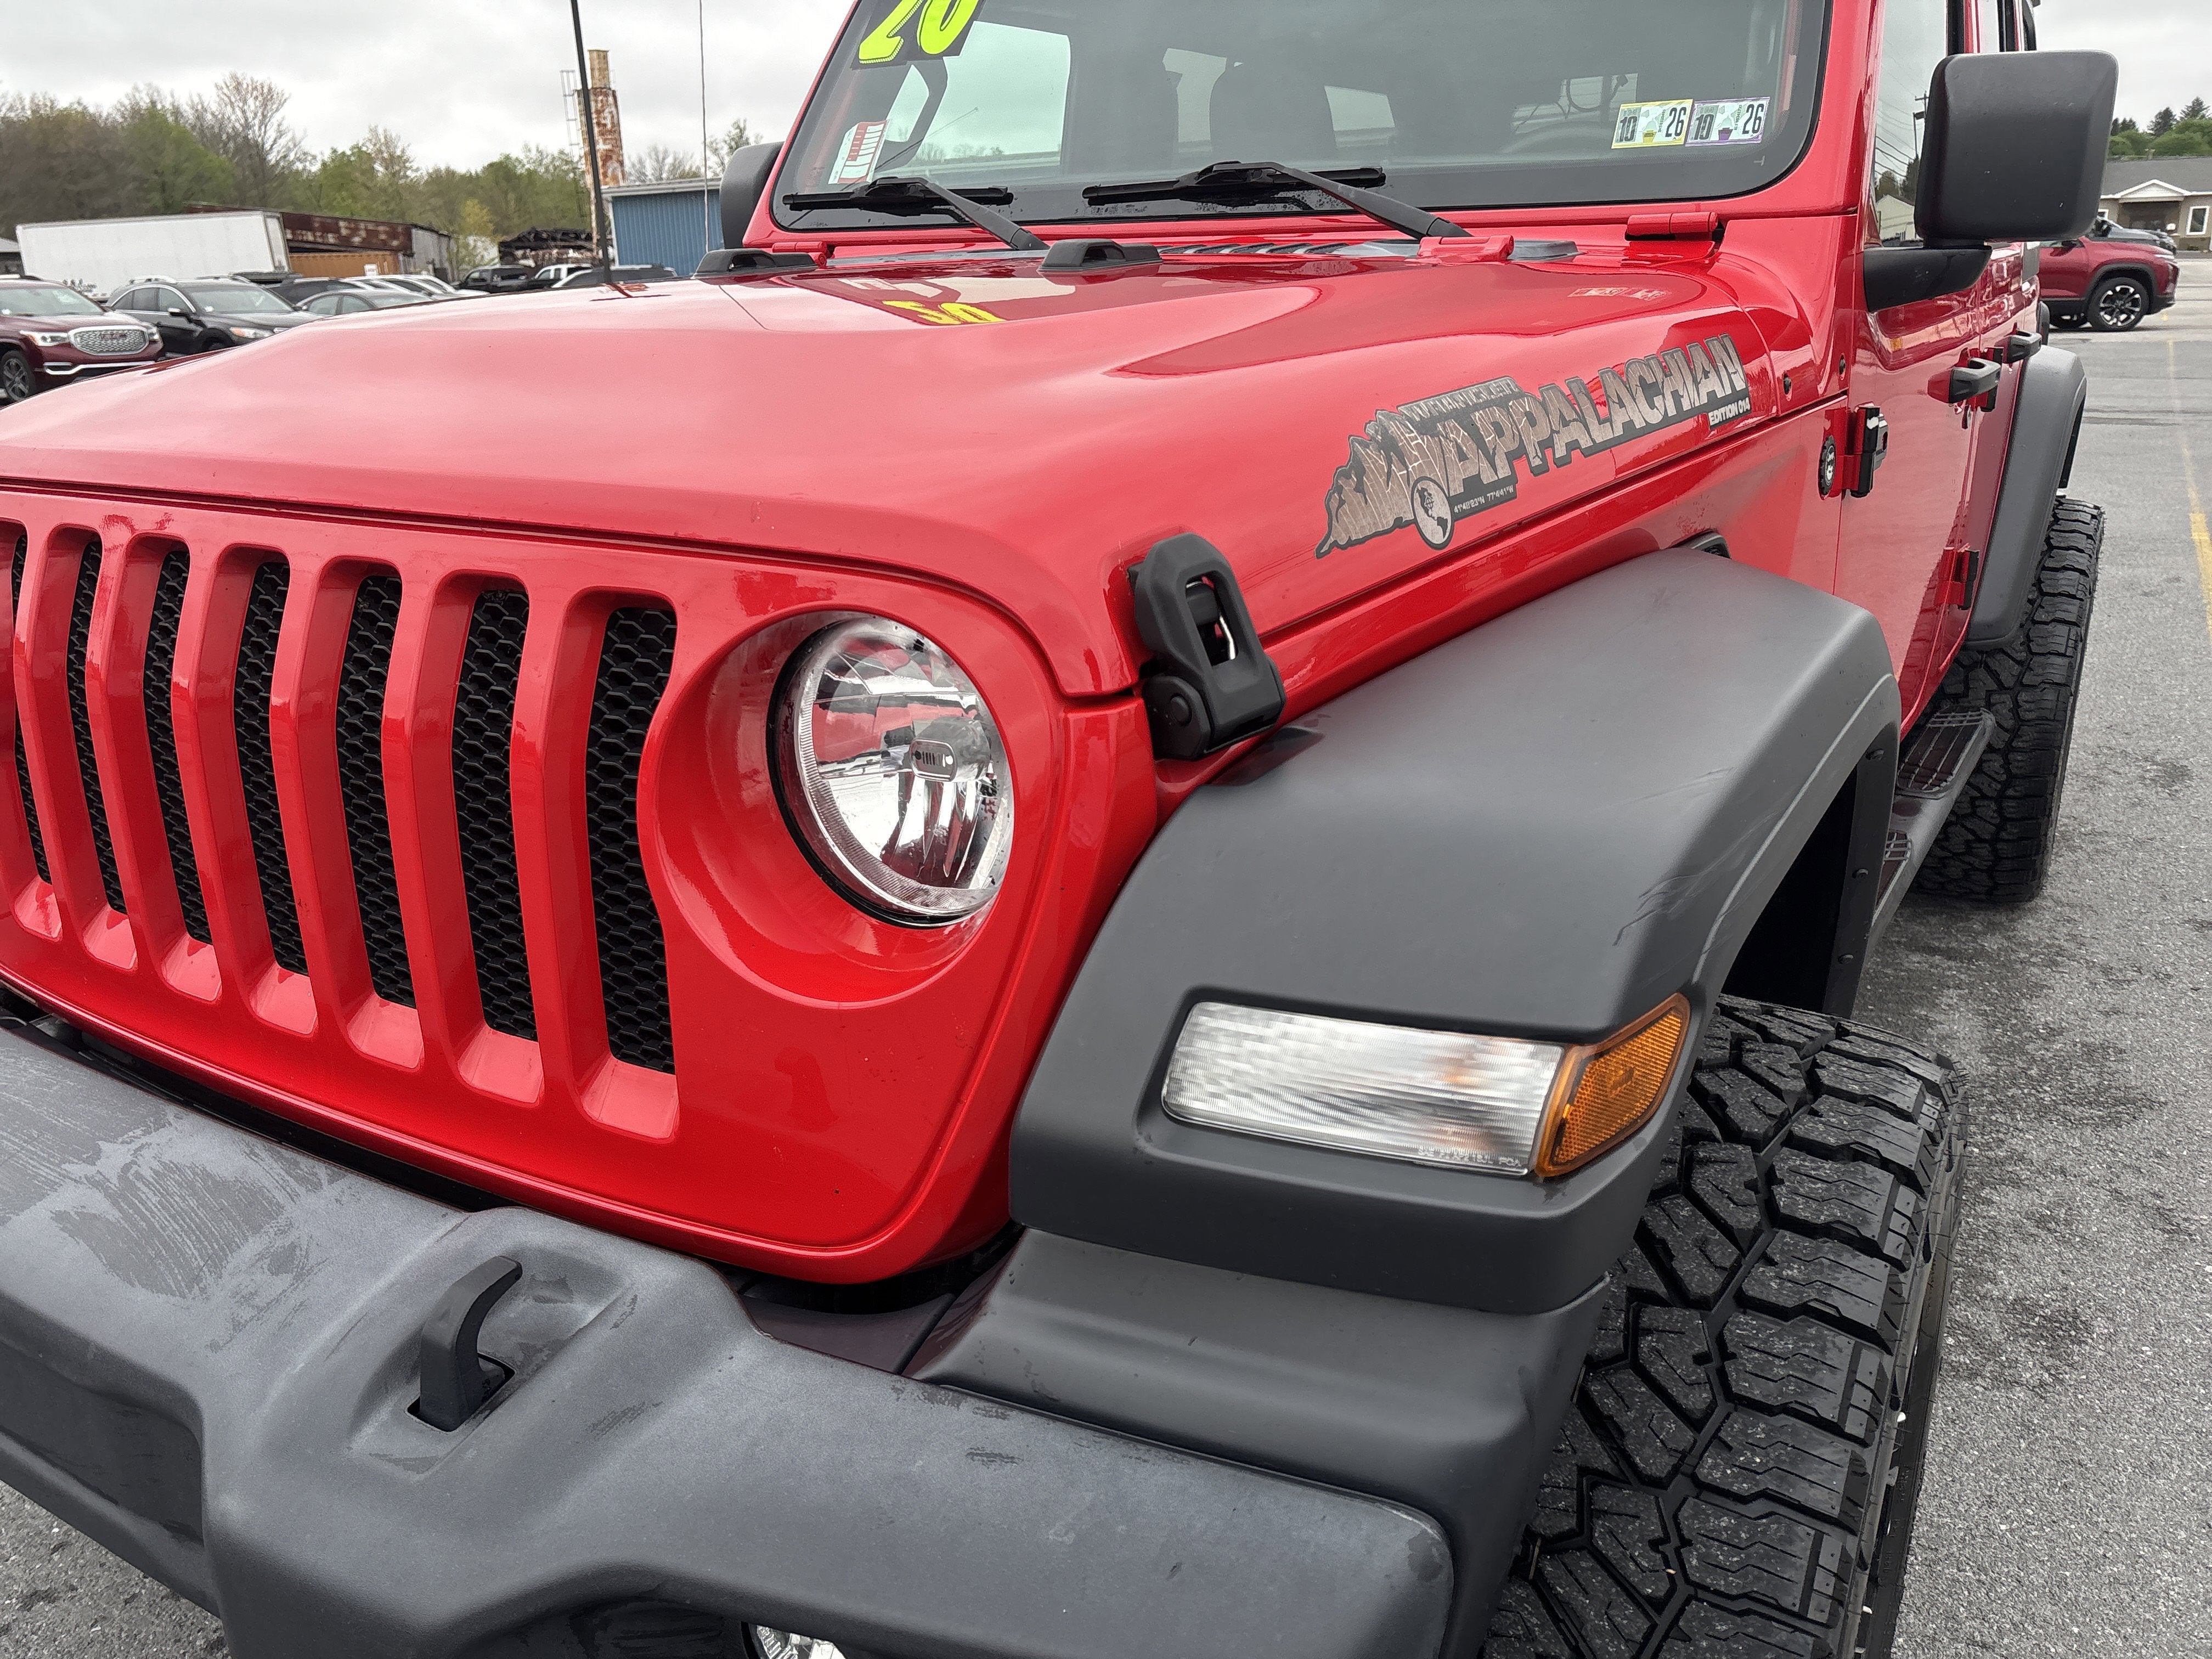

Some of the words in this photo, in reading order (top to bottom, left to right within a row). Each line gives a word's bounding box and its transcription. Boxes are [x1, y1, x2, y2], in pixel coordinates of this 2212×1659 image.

[1665, 106, 1687, 137] 26
[1742, 103, 1764, 134] 26
[1437, 334, 1747, 496] APPALACHIAN
[1708, 402, 1739, 426] EDITION
[1418, 1149, 1435, 1157] SAE
[1498, 1156, 1522, 1167] FCA
